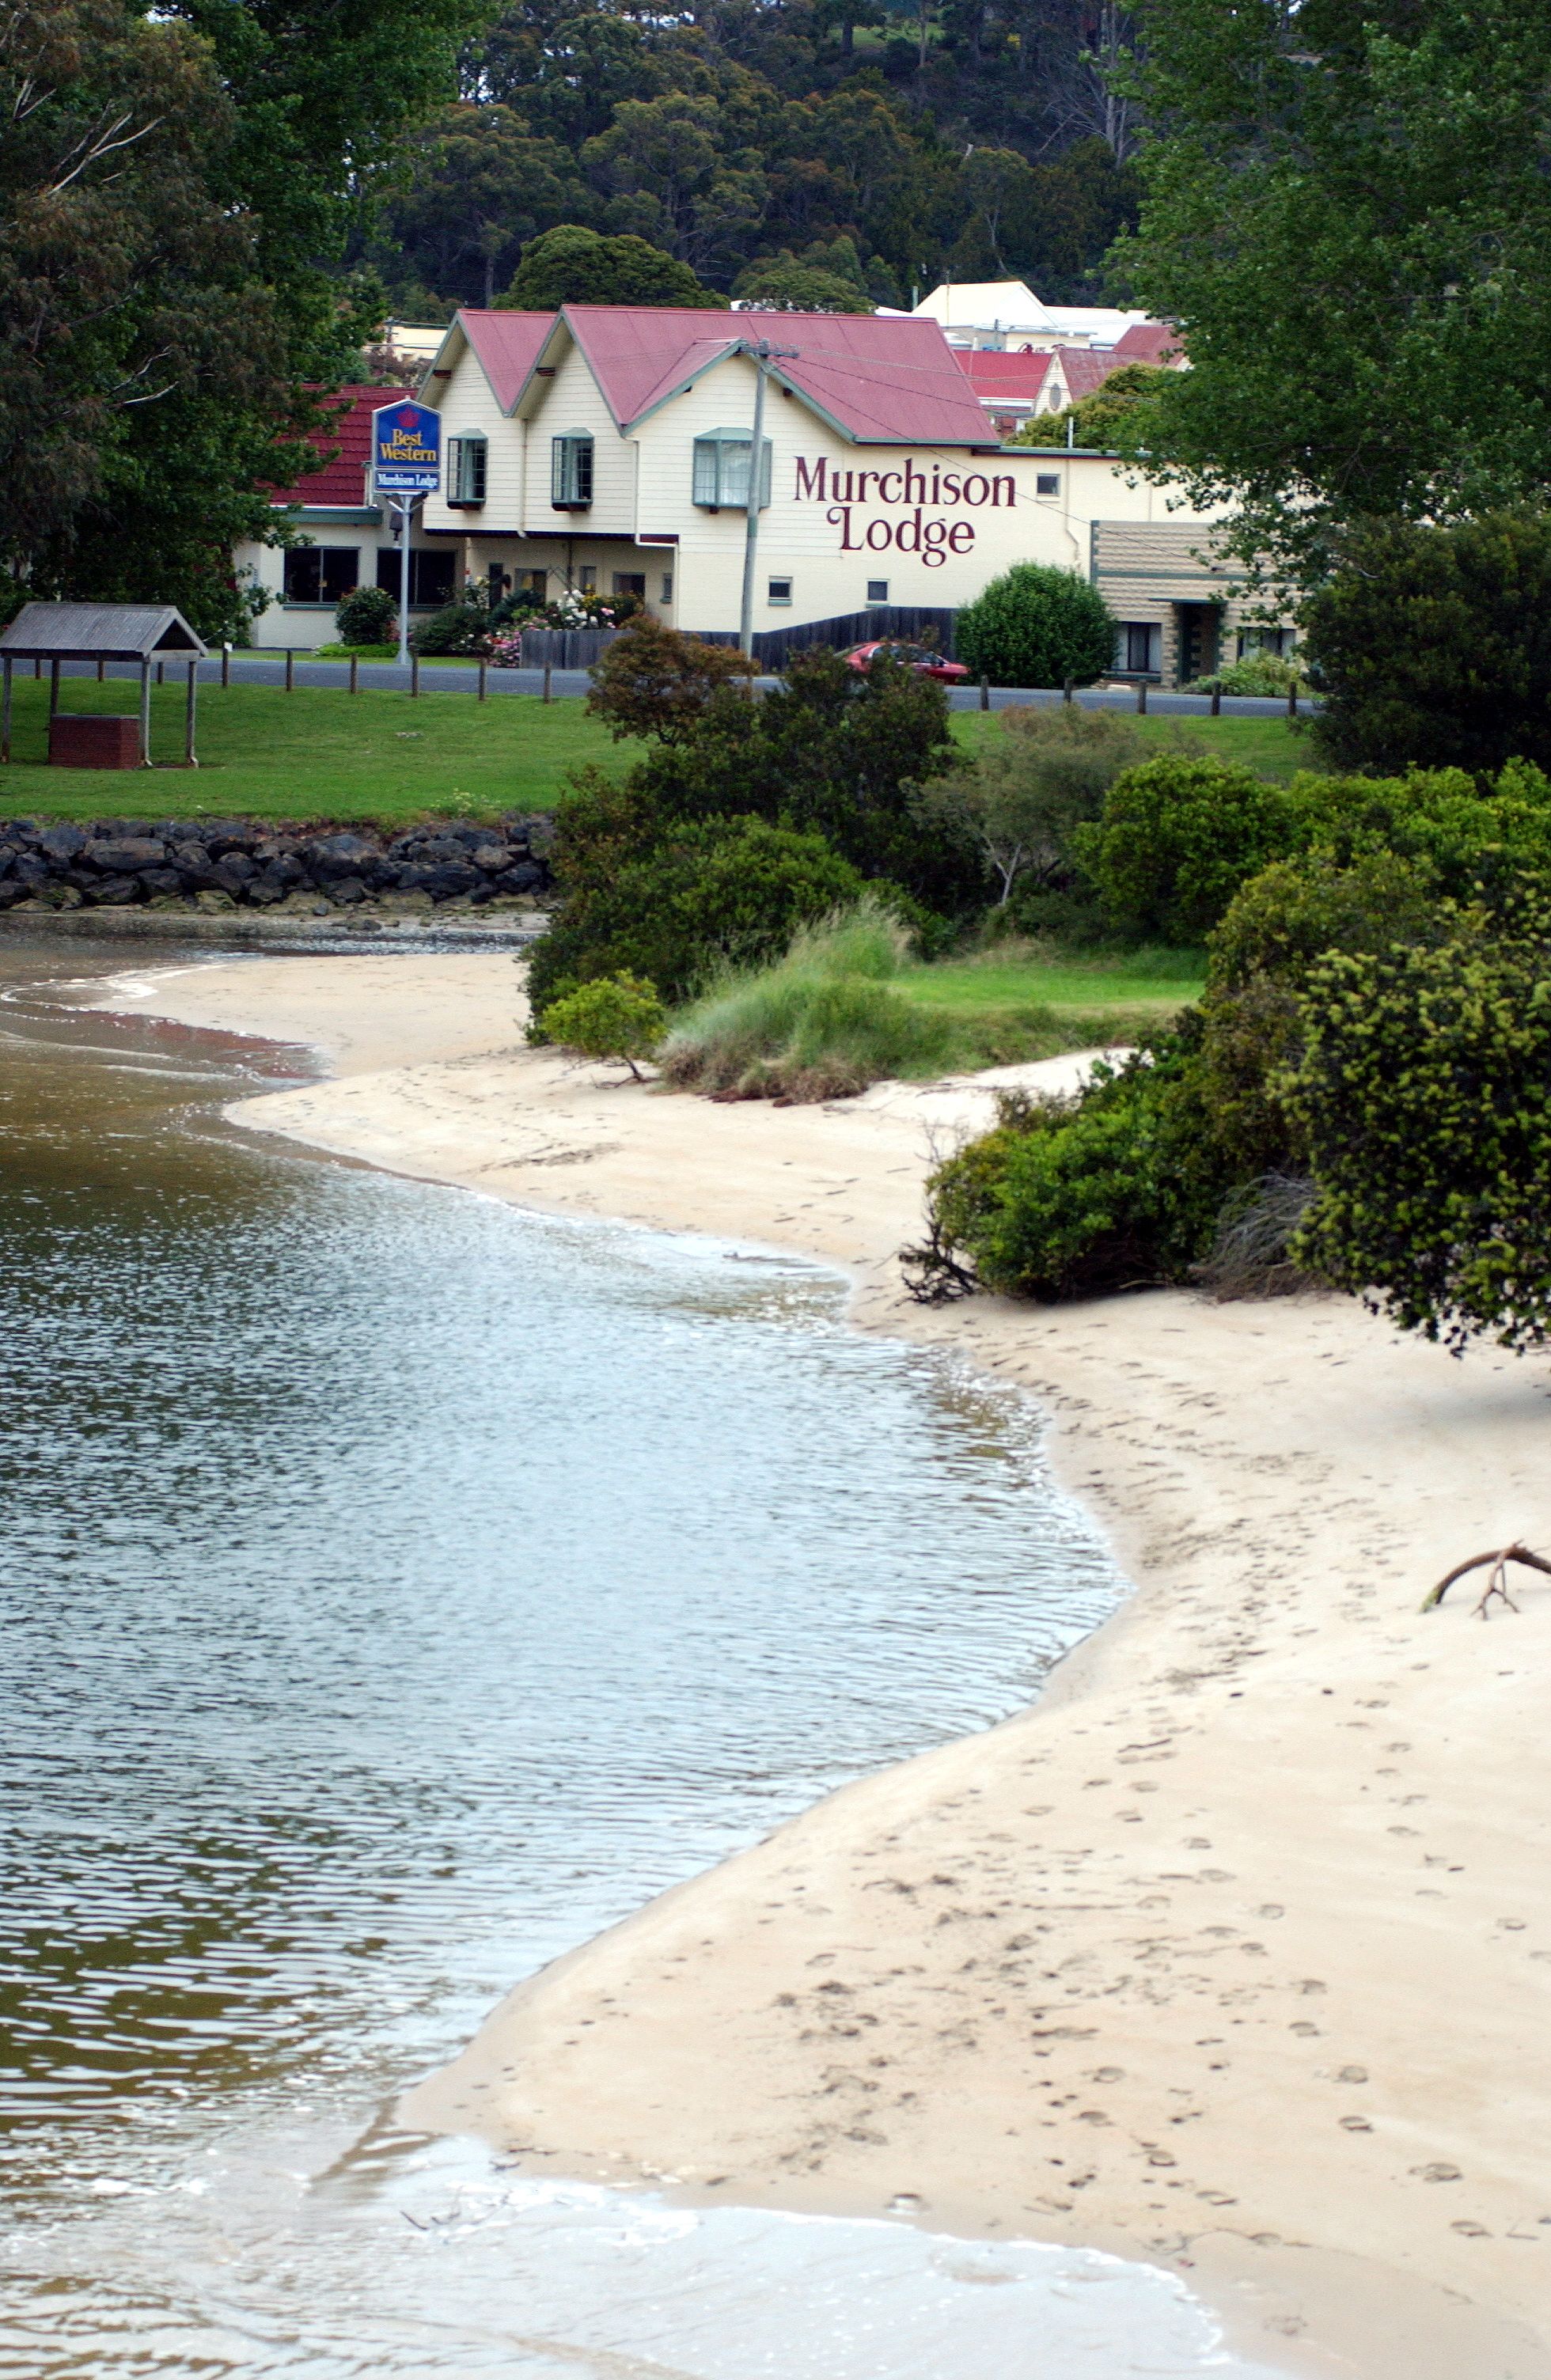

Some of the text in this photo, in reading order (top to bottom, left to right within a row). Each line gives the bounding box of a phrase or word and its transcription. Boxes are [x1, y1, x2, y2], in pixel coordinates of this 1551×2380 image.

[381, 443, 436, 460] Western
[392, 429, 423, 445] Best
[794, 456, 1018, 507] Murchison
[827, 506, 976, 567] Lodge
